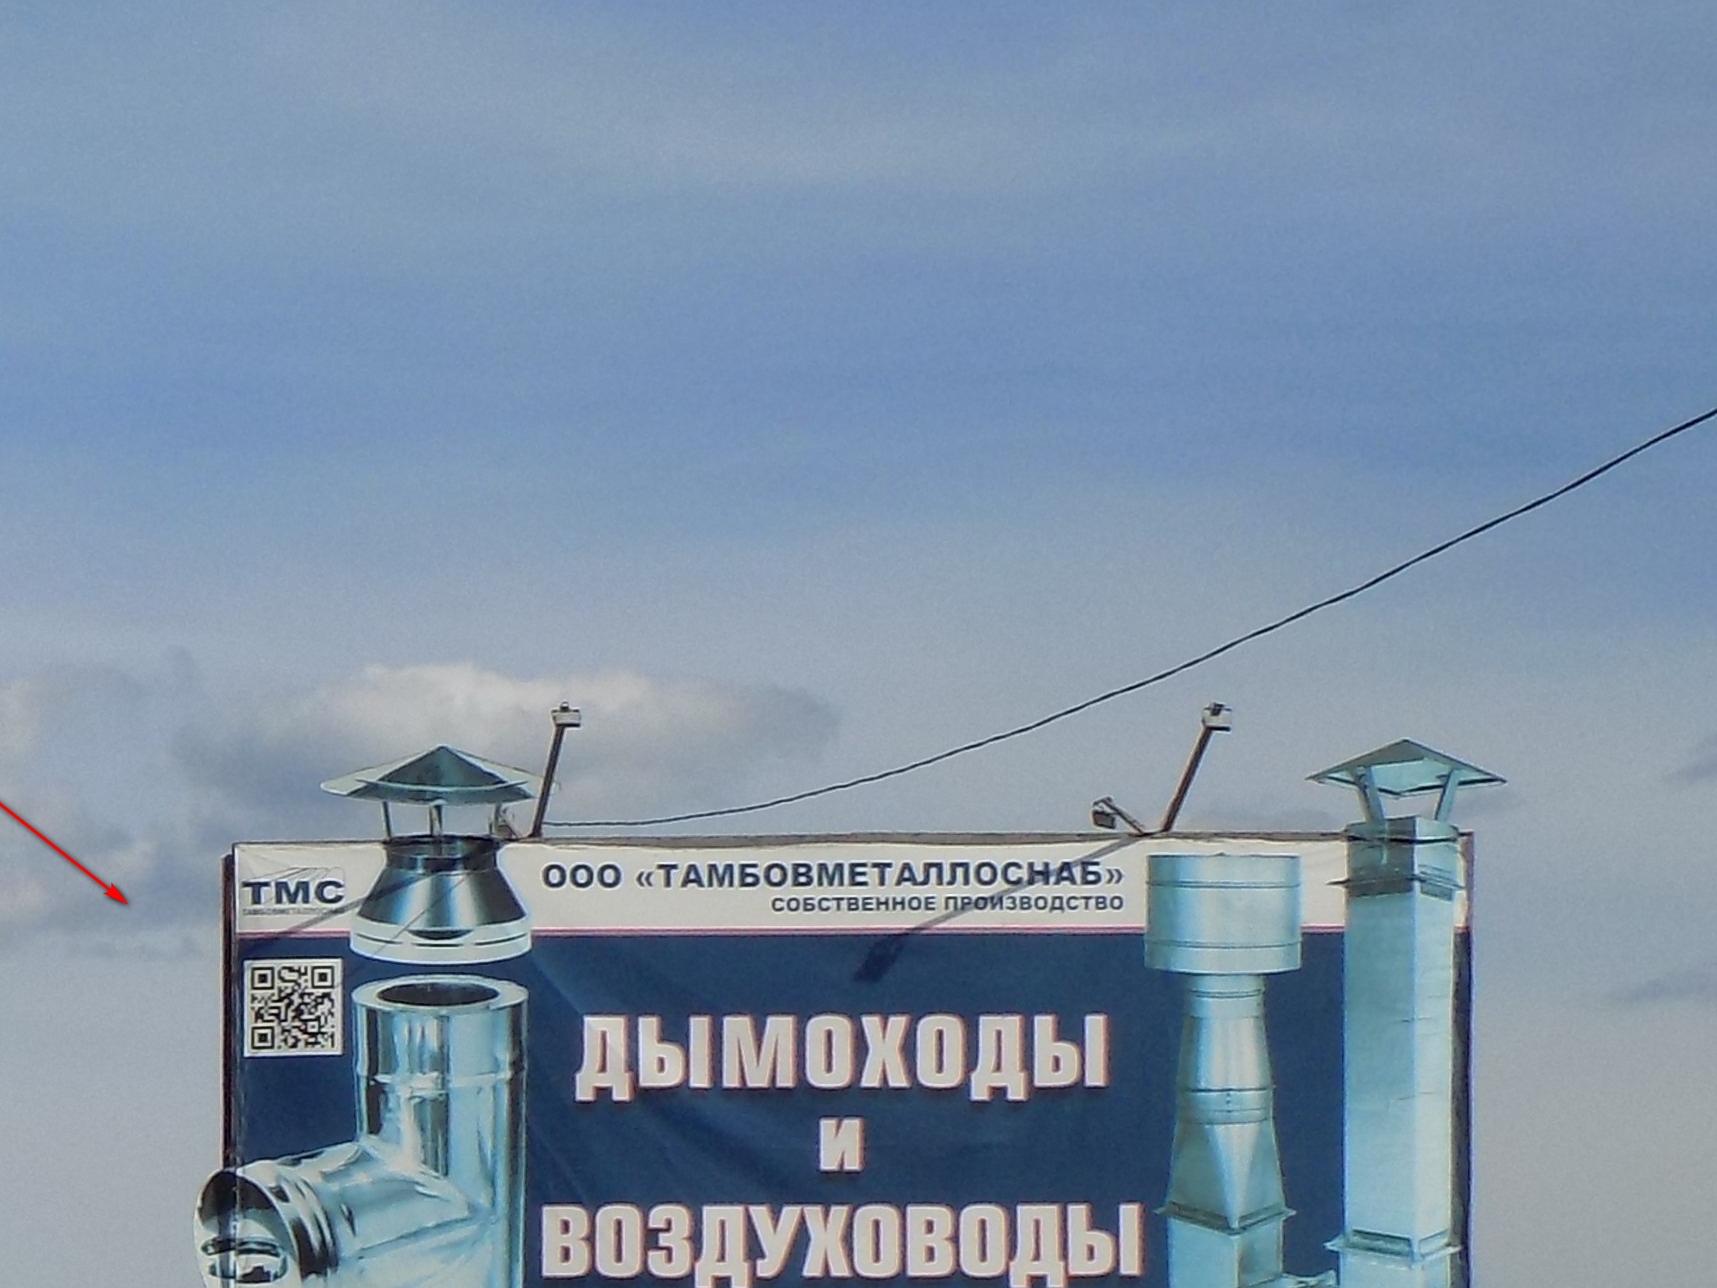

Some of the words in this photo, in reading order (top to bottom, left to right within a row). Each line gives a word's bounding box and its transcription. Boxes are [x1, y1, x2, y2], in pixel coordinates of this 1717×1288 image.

[542, 863, 622, 888] ООО
[635, 861, 1124, 889] «ТАМБОВМЕТАЛЛОСНАБ»
[242, 880, 345, 905] ТМС
[771, 896, 936, 912] СОБСТВЕННОЕ
[944, 895, 1124, 913] ПРОИЗВОДСТВО
[574, 1014, 1111, 1102] ДЫМОХОДЫ
